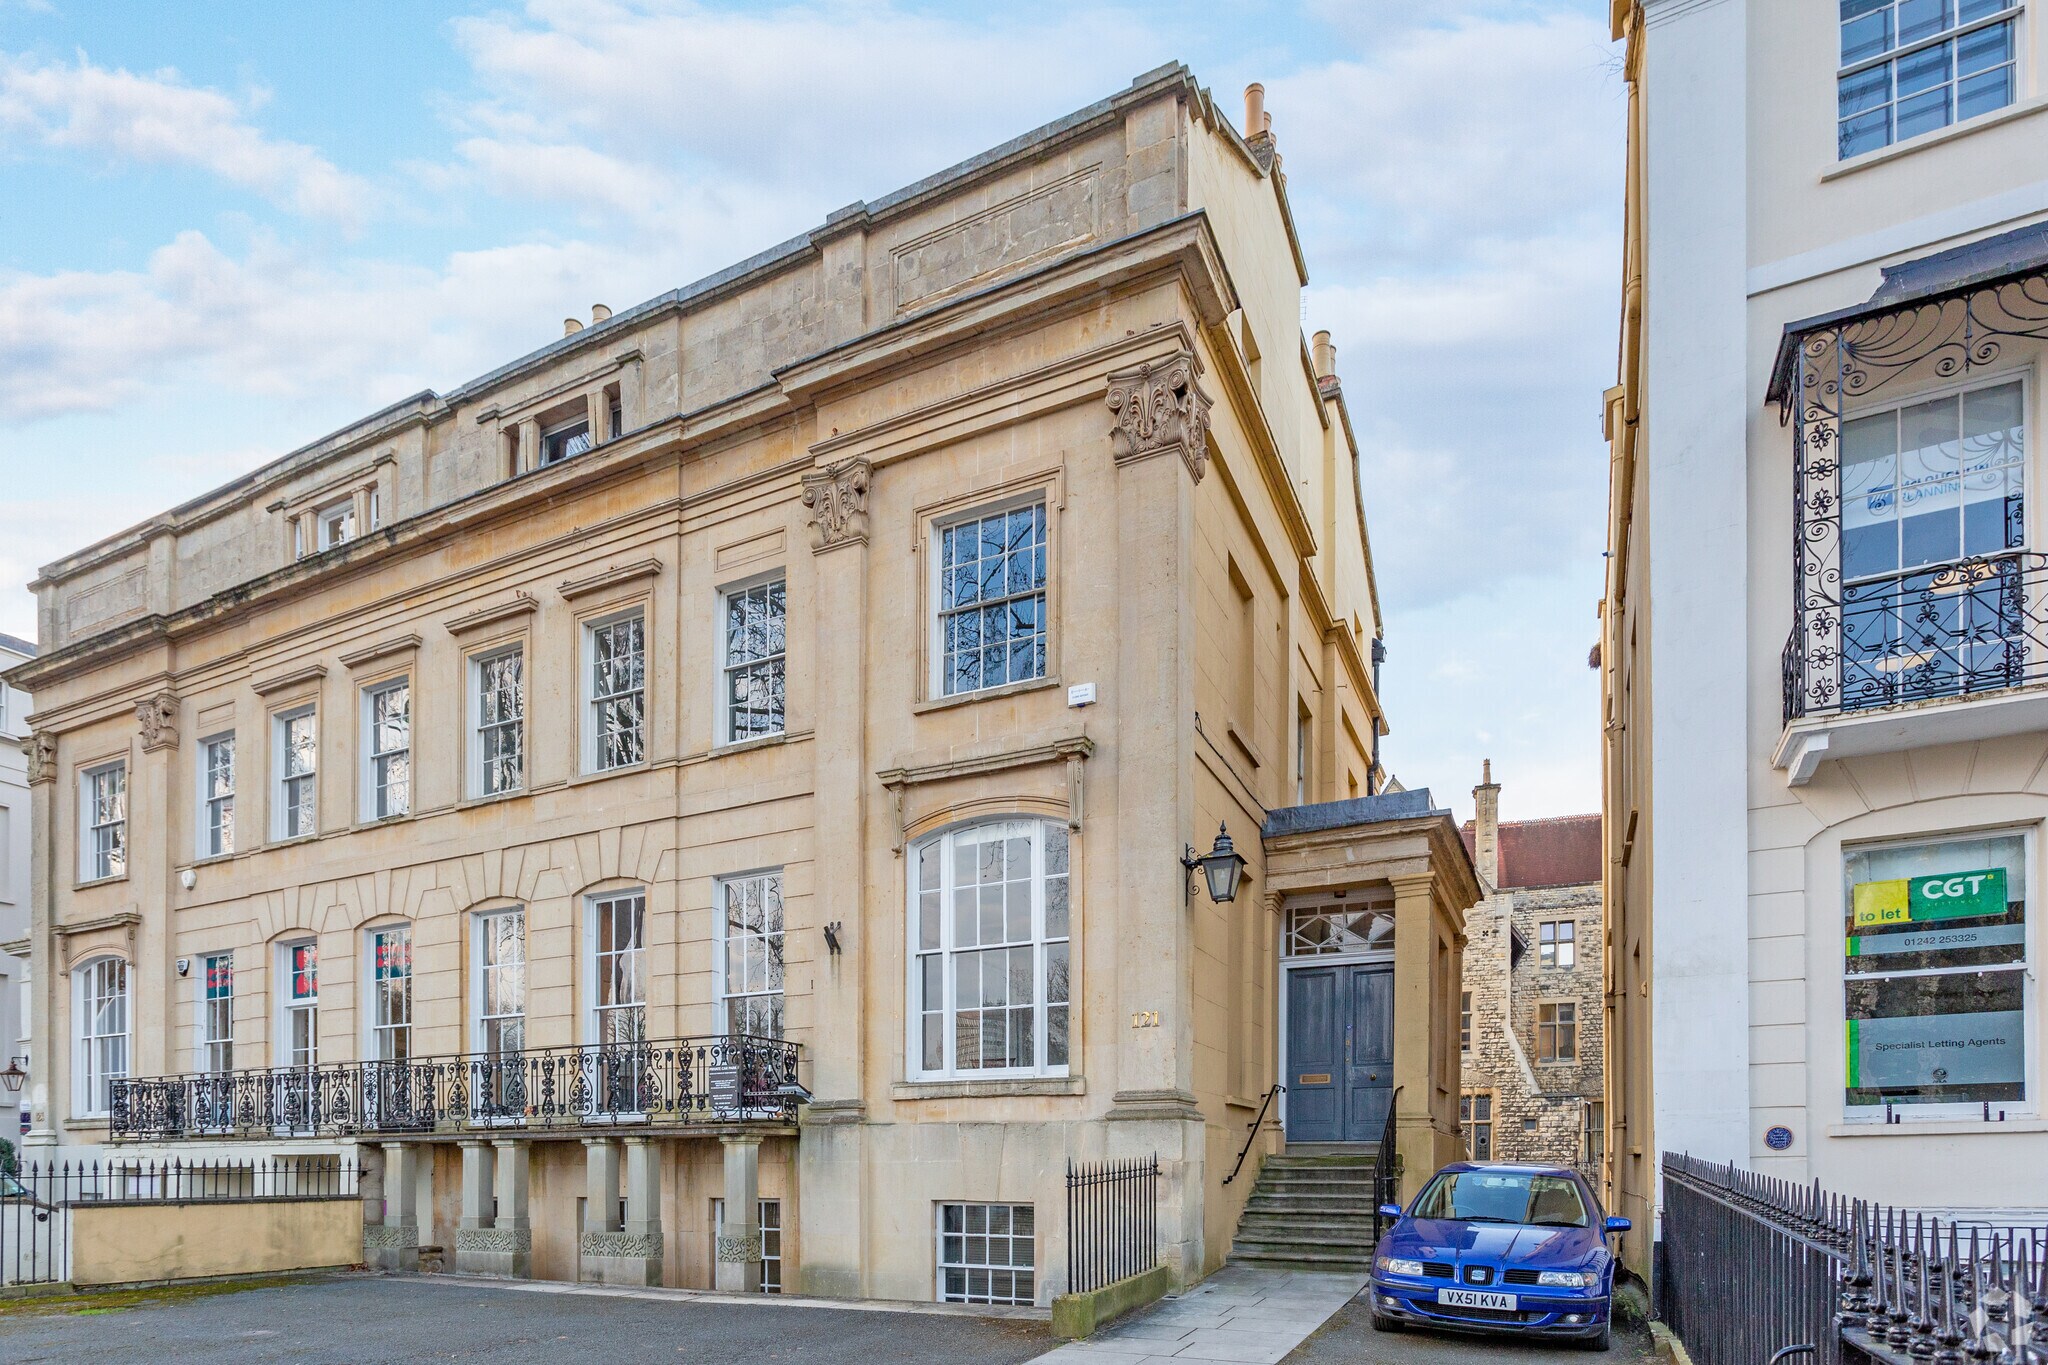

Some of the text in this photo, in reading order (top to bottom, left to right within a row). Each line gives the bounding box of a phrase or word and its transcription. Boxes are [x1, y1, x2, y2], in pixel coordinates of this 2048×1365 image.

[1922, 874, 1986, 899] CGT
[1860, 908, 1902, 922] to let
[1904, 933, 1978, 947] 01242 253325
[1131, 1011, 1160, 1028] 121
[1875, 1037, 2006, 1052] Specialist Letting Agents
[1447, 1291, 1507, 1308] VX51 KVA
